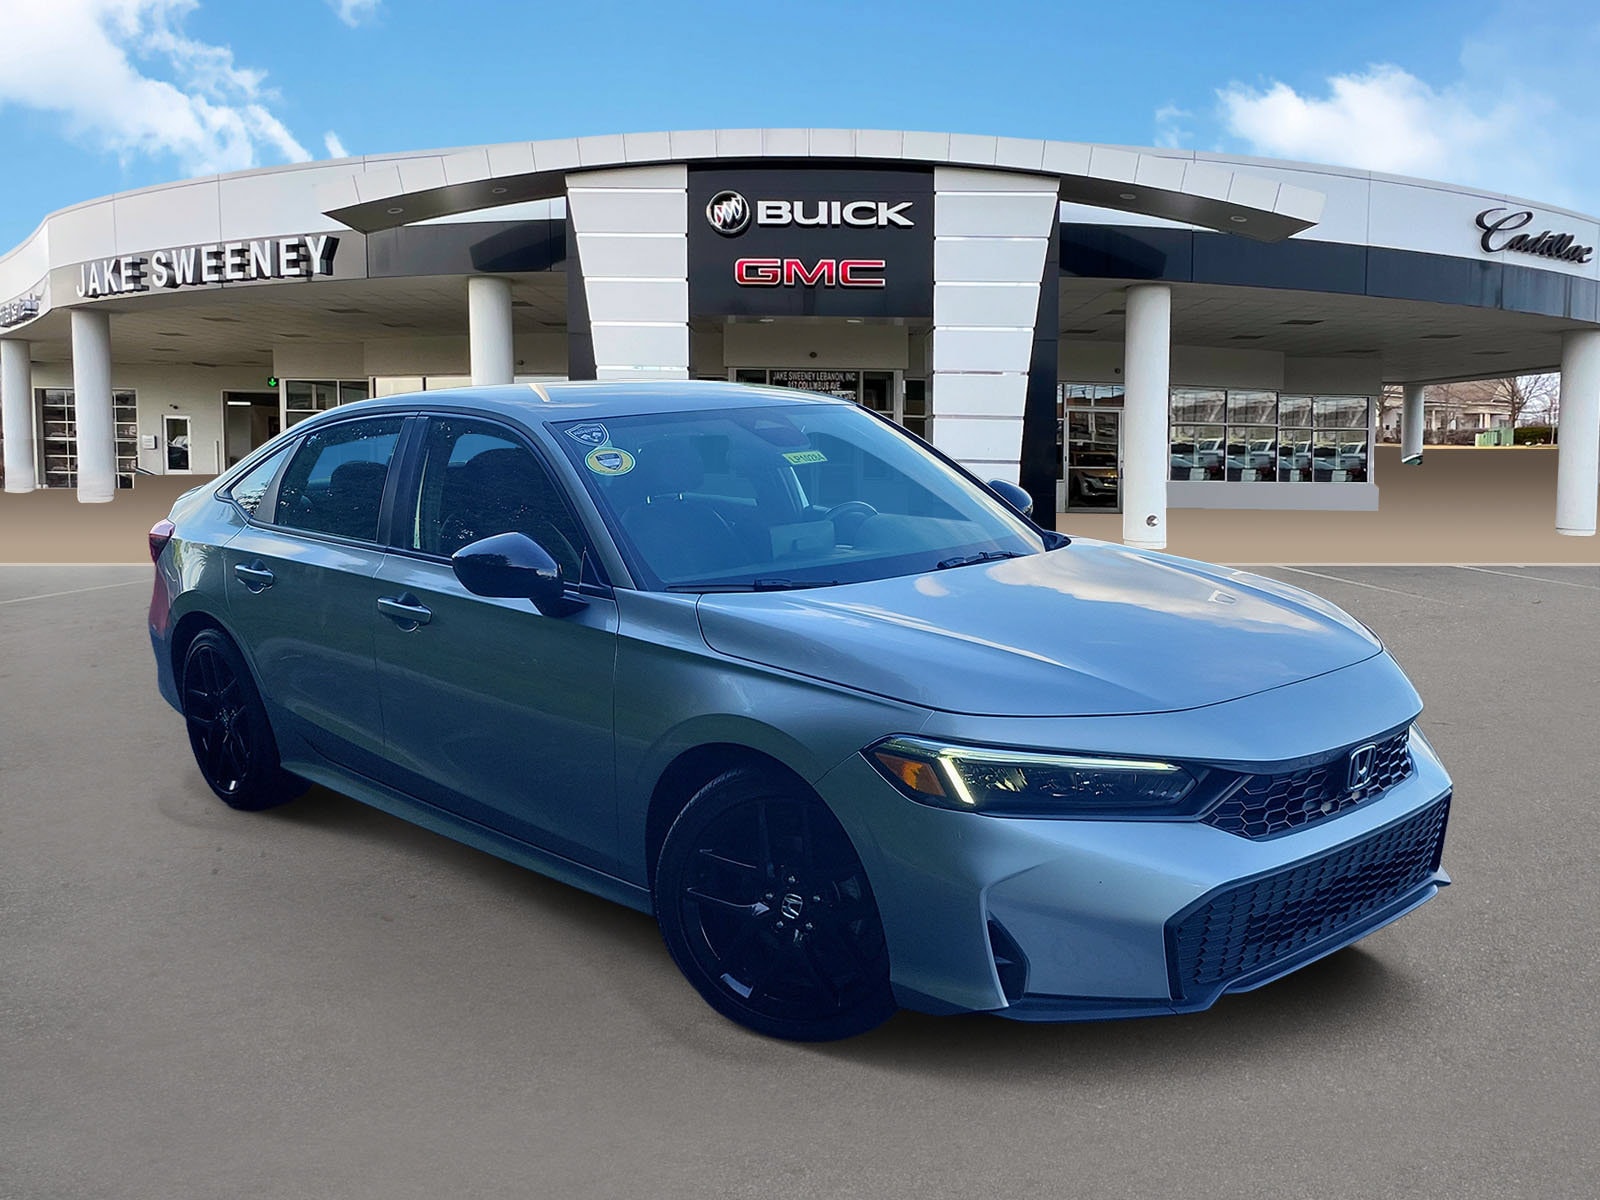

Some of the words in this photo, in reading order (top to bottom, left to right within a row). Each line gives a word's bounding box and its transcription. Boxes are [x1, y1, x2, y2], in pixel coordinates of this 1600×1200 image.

[757, 200, 915, 226] BUICK
[1475, 207, 1593, 264] Cadillac
[76, 256, 145, 298] JAKE
[151, 235, 334, 288] SWEENEY
[734, 258, 886, 287] GMC
[773, 371, 788, 381] JAKE
[788, 371, 816, 381] SWEENEY
